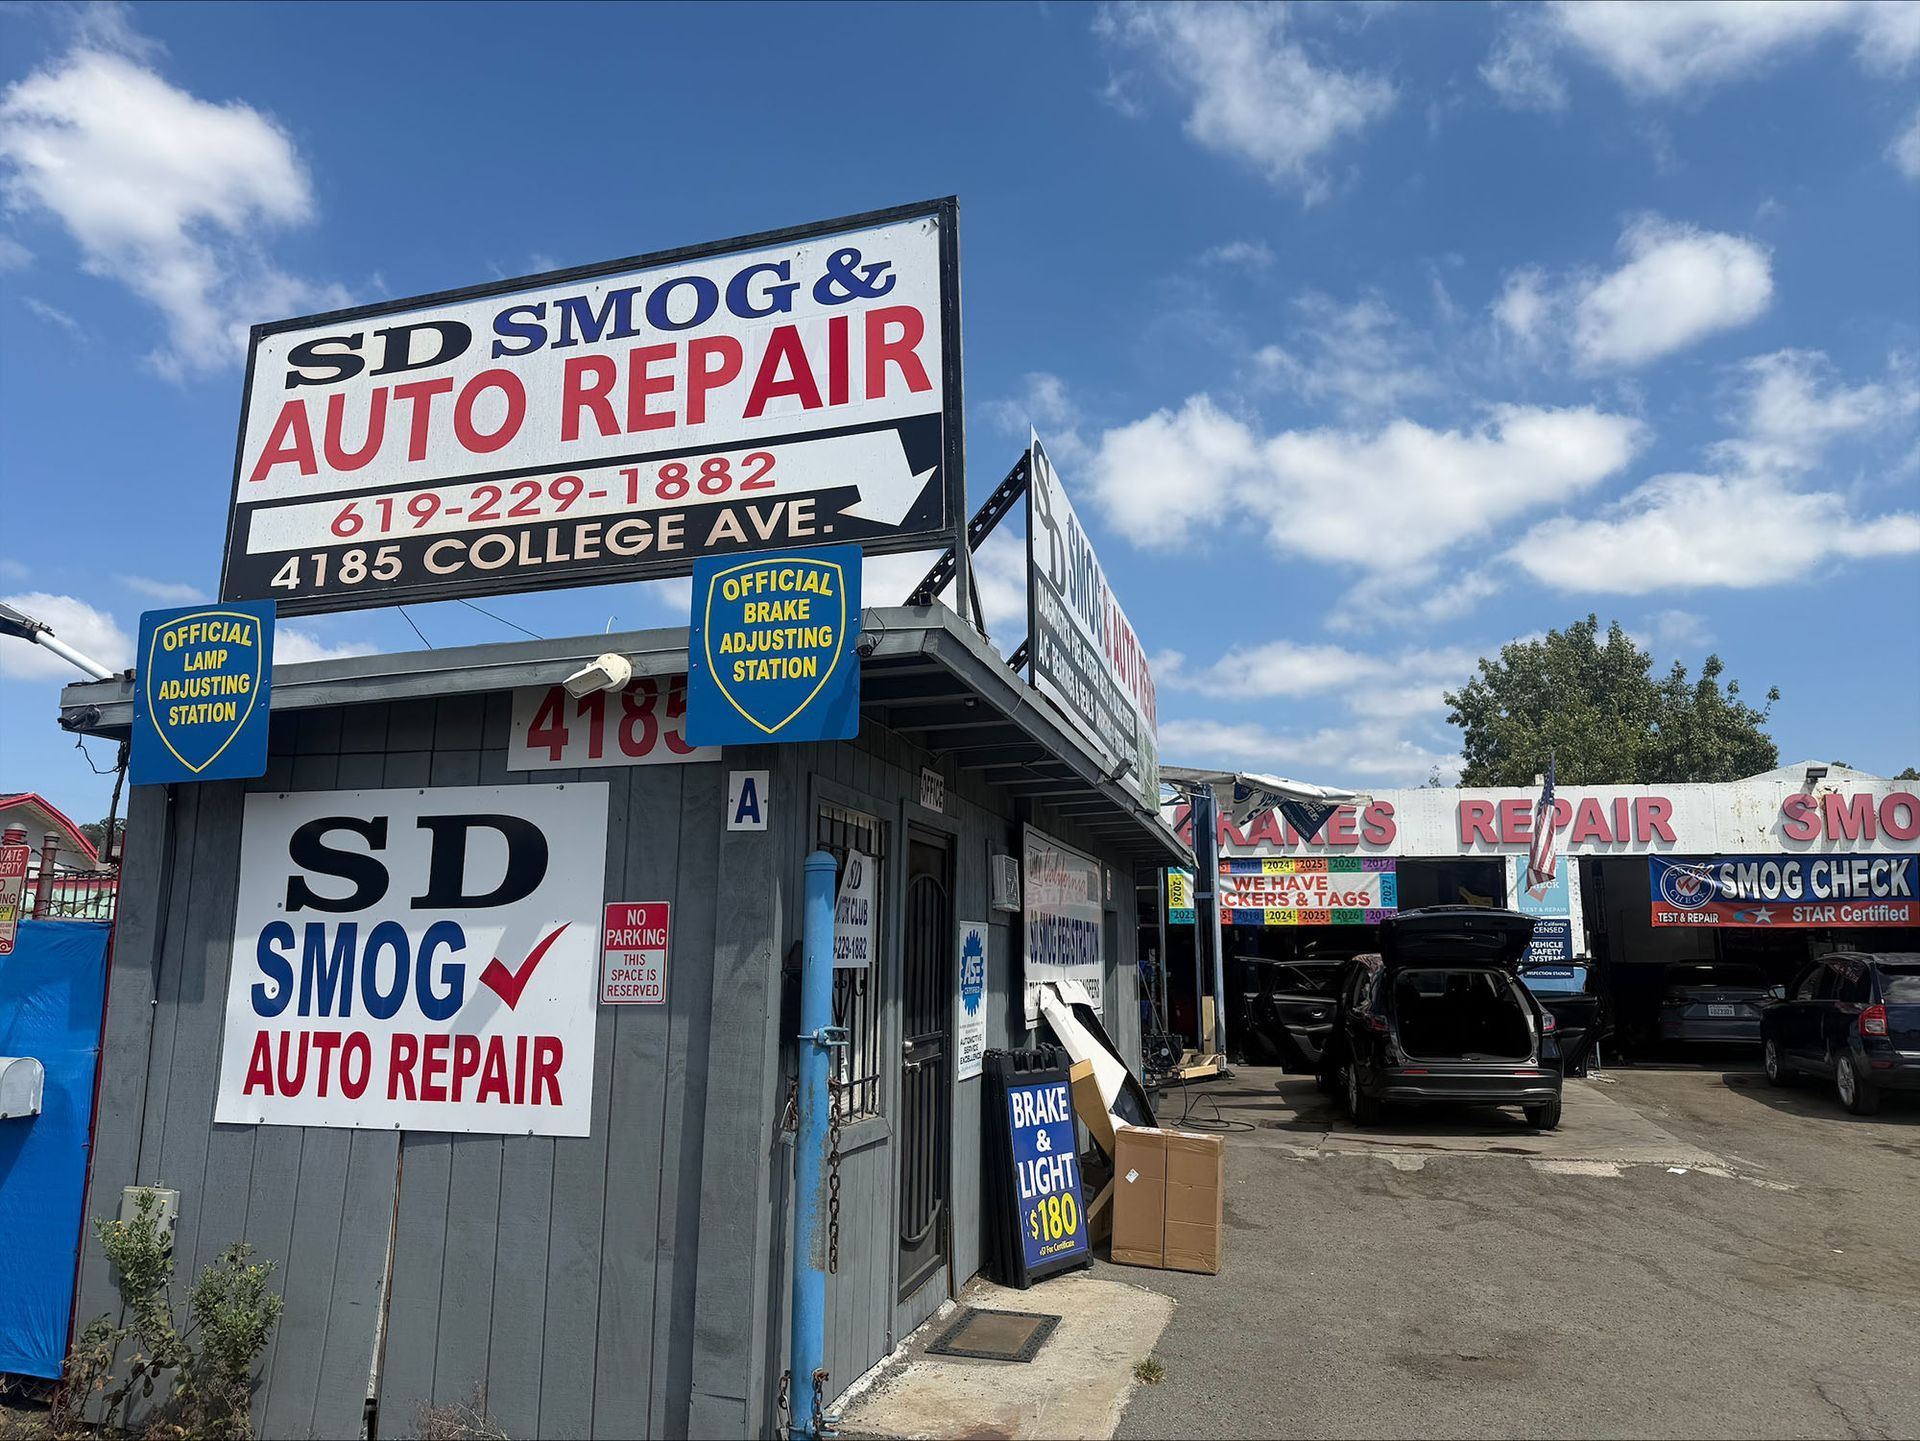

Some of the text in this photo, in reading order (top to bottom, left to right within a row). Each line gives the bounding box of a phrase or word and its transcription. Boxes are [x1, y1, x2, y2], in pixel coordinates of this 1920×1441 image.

[284, 247, 896, 390] SD SMOG &
[250, 305, 932, 482] AUTO REPAIR
[331, 451, 776, 538] 619-229-1882
[270, 497, 835, 591] 4185 COLLEGE AVE.
[1033, 440, 1066, 598] SD
[1068, 512, 1102, 647] SMOG
[1112, 604, 1138, 700] AUTO
[722, 568, 834, 601] OFFICIAL
[743, 598, 811, 624] BRAKE
[163, 620, 253, 653] OFFICIAL
[719, 625, 833, 653] ADJUSTING
[183, 648, 229, 673] LAMP
[733, 655, 817, 683] STATION
[159, 672, 251, 701] ADJUSTING
[168, 700, 237, 726] STATION
[526, 678, 699, 761] 4185
[734, 777, 762, 824] A
[1459, 796, 1678, 844] REPAIR
[1782, 793, 1920, 841] SMO
[0, 850, 23, 861] VATE
[0, 862, 22, 874] ERTY
[285, 814, 549, 913] SD
[1267, 861, 1290, 869] 2024
[1300, 860, 1323, 868] 2025
[1334, 859, 1357, 868] 2026
[846, 860, 862, 890] SD
[1232, 876, 1328, 891] WE HAVE
[1719, 858, 1911, 899] SMOG CHECK
[1172, 880, 1182, 903] 2026
[1220, 891, 1371, 907] CKERS & TAGS
[1382, 880, 1393, 902] 2027
[627, 909, 646, 926] NO
[850, 898, 868, 926] CLUB
[1270, 911, 1293, 920] 2024
[1303, 911, 1326, 920] 2025
[1336, 911, 1359, 919] 2026
[1658, 912, 1719, 924] TEST & REPAIR
[1792, 904, 1909, 922] STAR Certified
[606, 928, 666, 946] PARKING
[834, 936, 867, 959] -229-1882
[1058, 915, 1100, 965] REGISTRATION
[250, 920, 467, 1020] SMOG
[624, 953, 646, 966] THIS
[963, 956, 981, 985] ASE
[611, 969, 656, 981] SPACE IS
[607, 984, 659, 997] RESERVED
[243, 1029, 564, 1106] AUTO REPAIR
[1011, 1087, 1069, 1128] BRAKE
[1036, 1129, 1052, 1152] &
[1017, 1152, 1074, 1198] LIGHT
[1030, 1192, 1077, 1241] $180
